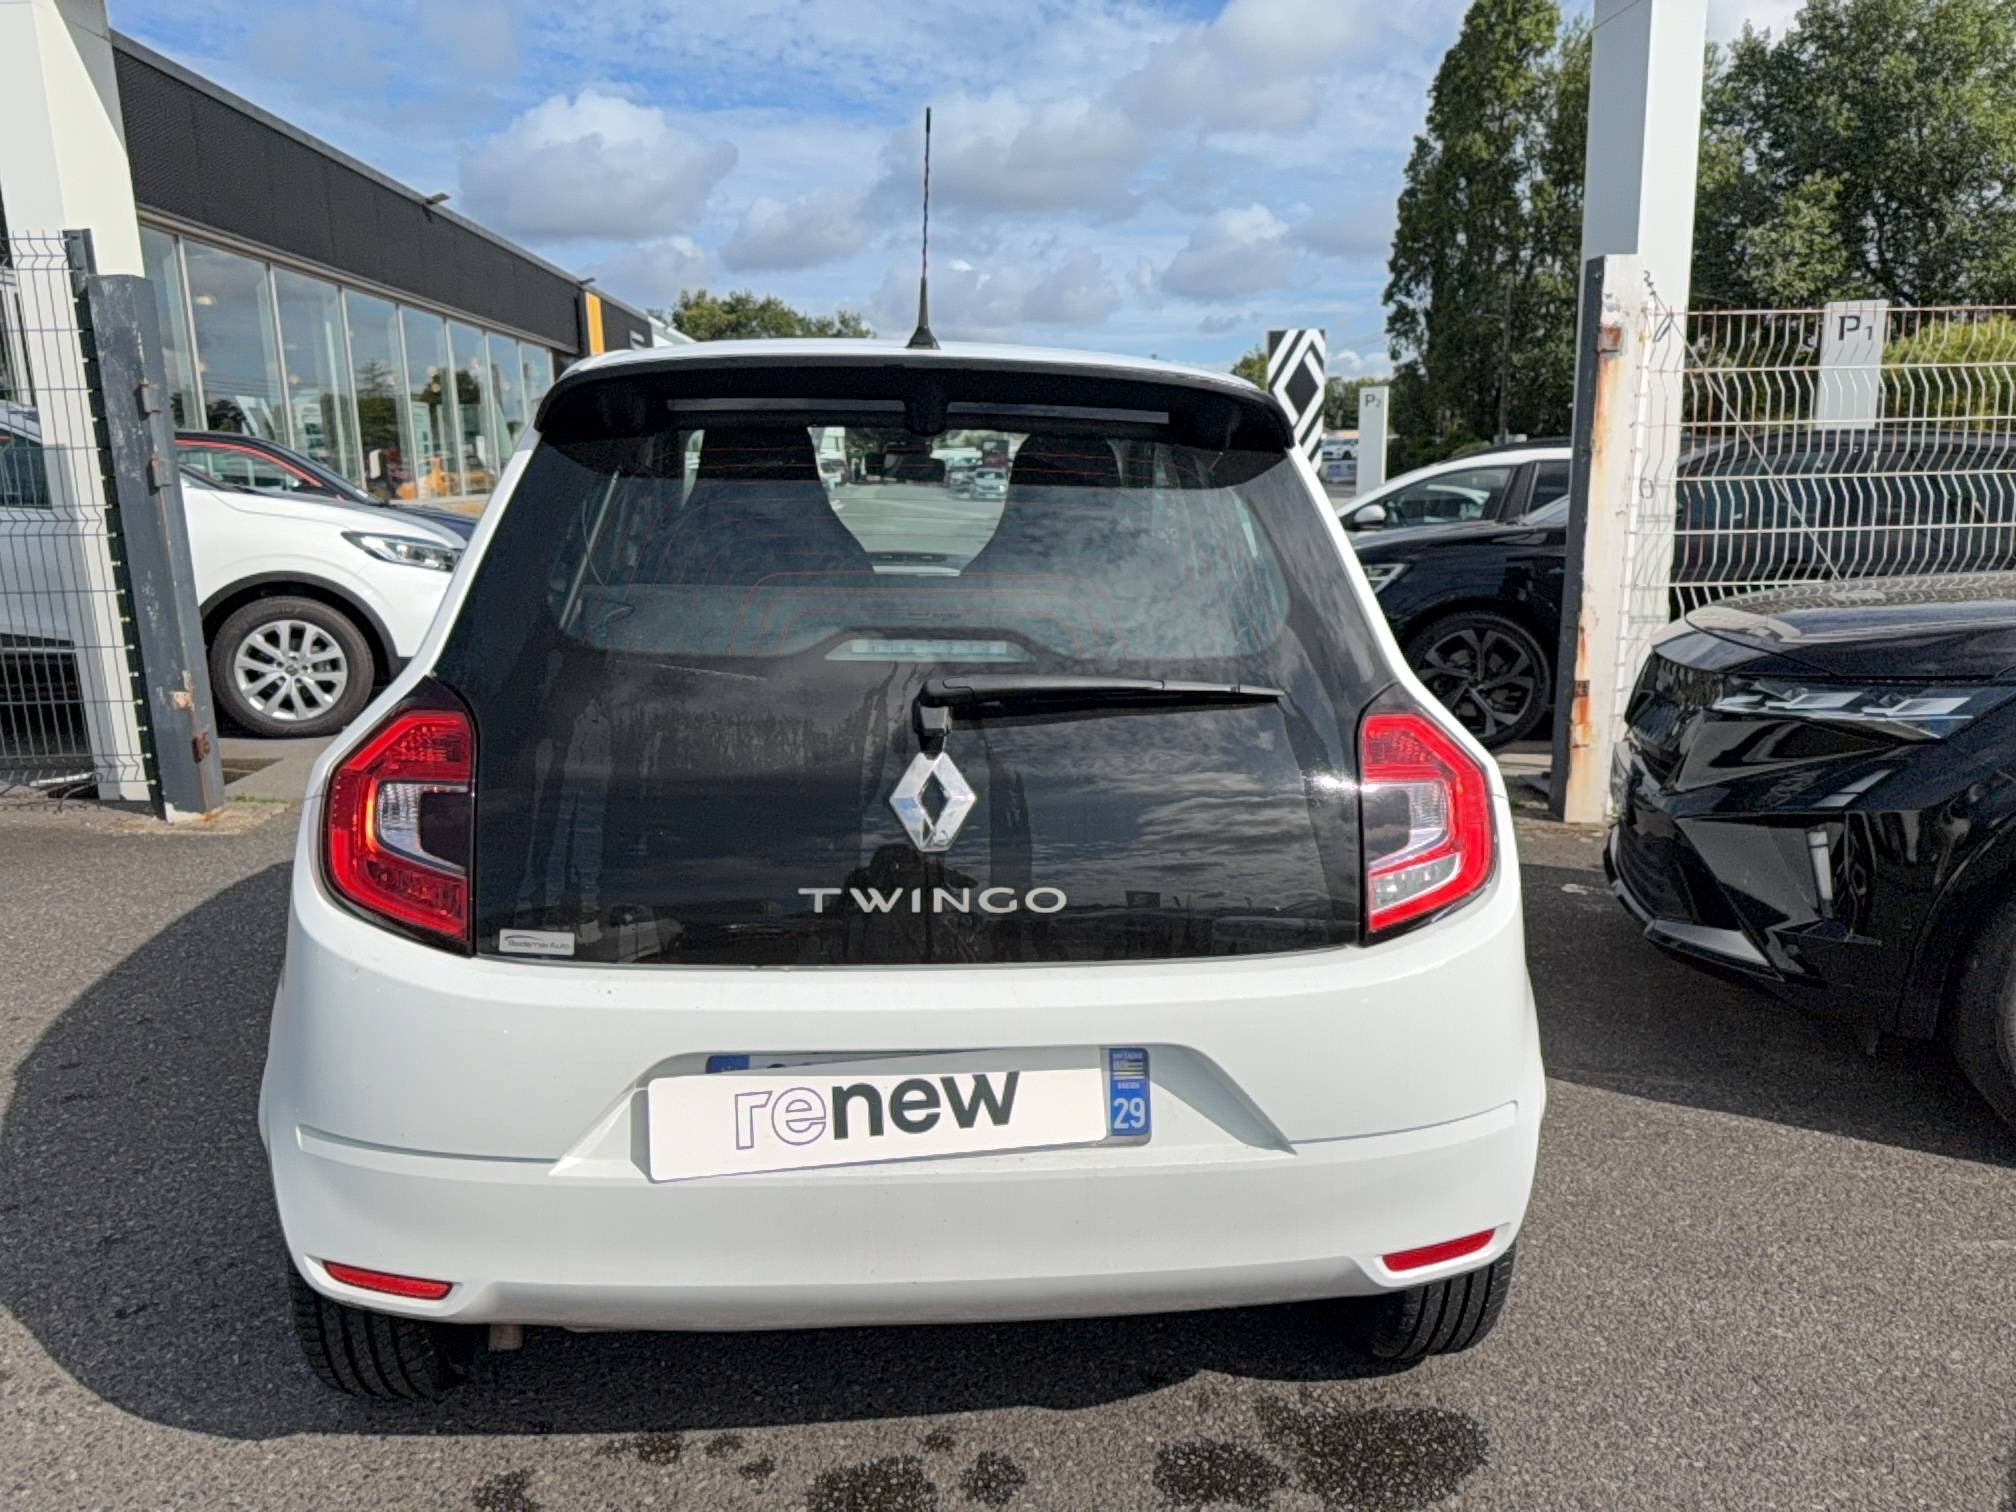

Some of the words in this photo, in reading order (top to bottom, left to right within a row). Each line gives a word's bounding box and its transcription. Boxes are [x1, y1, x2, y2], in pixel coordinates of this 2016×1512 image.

[1838, 315, 1873, 341] P1
[798, 887, 1067, 914] TWINGO
[735, 1070, 1019, 1150] renew
[1113, 1097, 1146, 1129] 29
